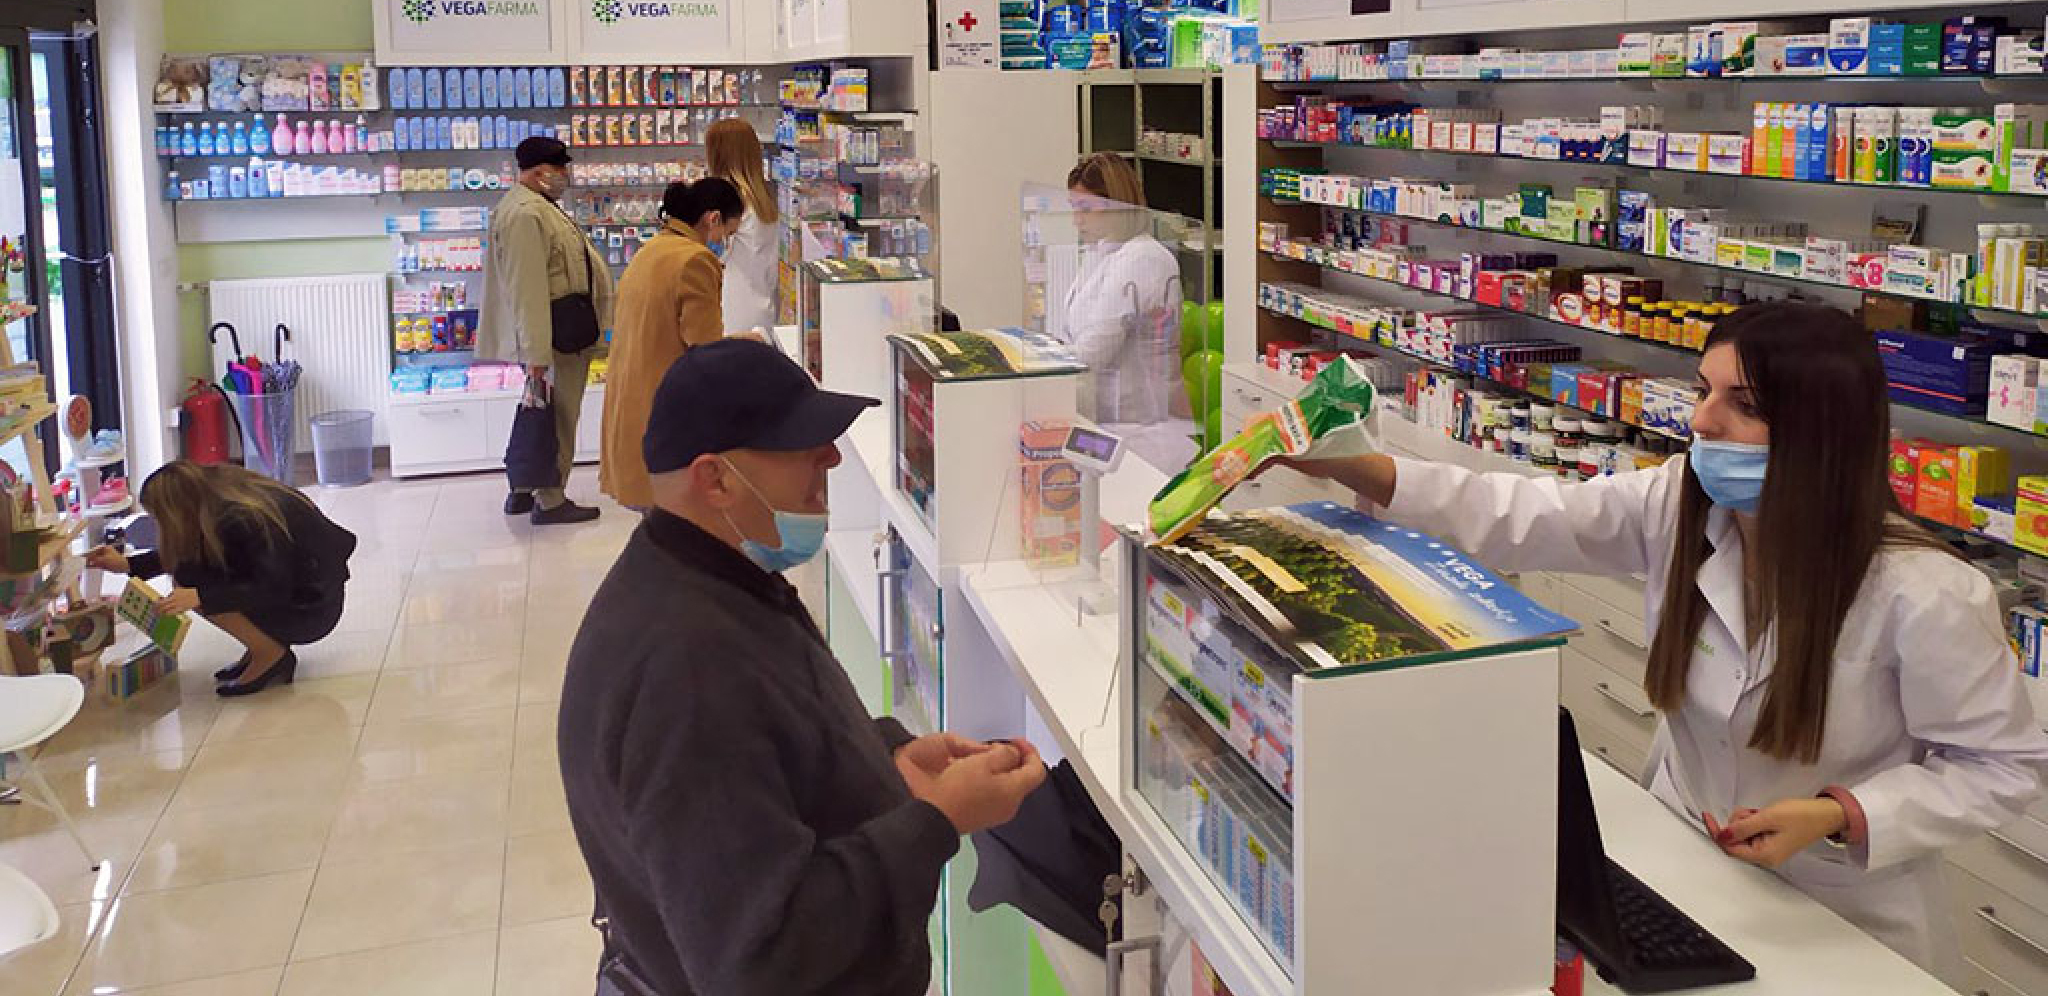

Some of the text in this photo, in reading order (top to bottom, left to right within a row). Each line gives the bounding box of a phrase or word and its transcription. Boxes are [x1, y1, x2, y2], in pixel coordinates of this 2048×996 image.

[441, 0, 539, 16] VEGAFARMA
[627, 2, 719, 18] VEGAFARMA
[1446, 557, 1495, 590] VEGA
